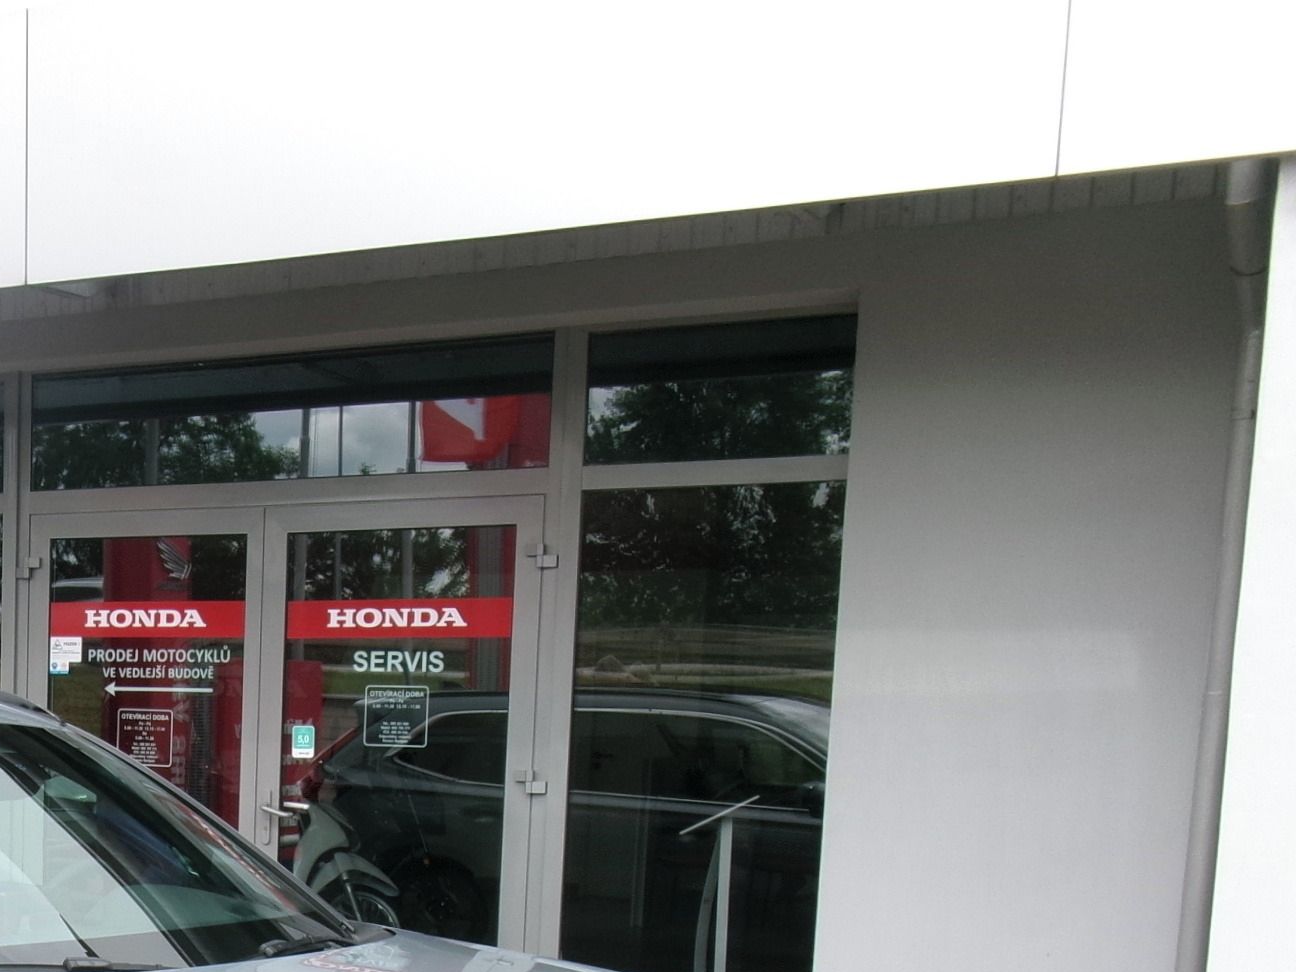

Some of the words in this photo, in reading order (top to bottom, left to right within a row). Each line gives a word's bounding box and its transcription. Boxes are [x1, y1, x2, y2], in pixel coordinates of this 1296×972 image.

[84, 609, 207, 628] HONDA
[327, 607, 467, 628] HONDA
[88, 649, 139, 663] PRODEJ
[143, 645, 231, 664] MOTOCYKLŮ
[353, 651, 444, 673] SERVIS
[102, 667, 117, 679] VE
[118, 665, 166, 680] VEDLEJŠÍ
[168, 665, 215, 680] BUDOVĚ
[297, 734, 310, 745] 5,0
